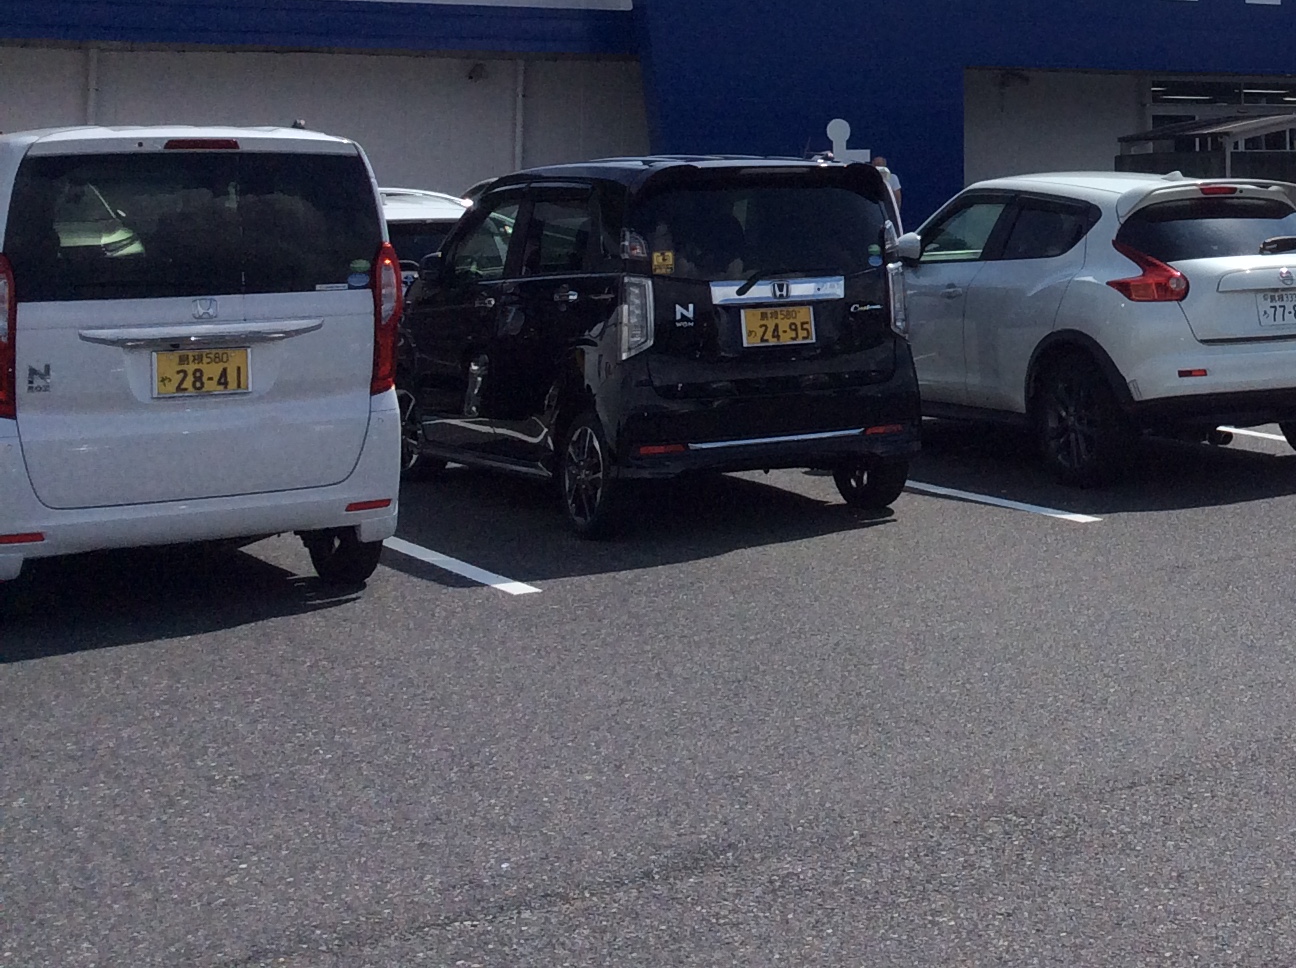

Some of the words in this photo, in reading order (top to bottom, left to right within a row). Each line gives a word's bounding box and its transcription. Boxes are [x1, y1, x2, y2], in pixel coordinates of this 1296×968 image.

[675, 303, 694, 320] N
[759, 321, 810, 343] 24-95
[28, 364, 50, 385] N
[175, 365, 242, 393] 28-41
